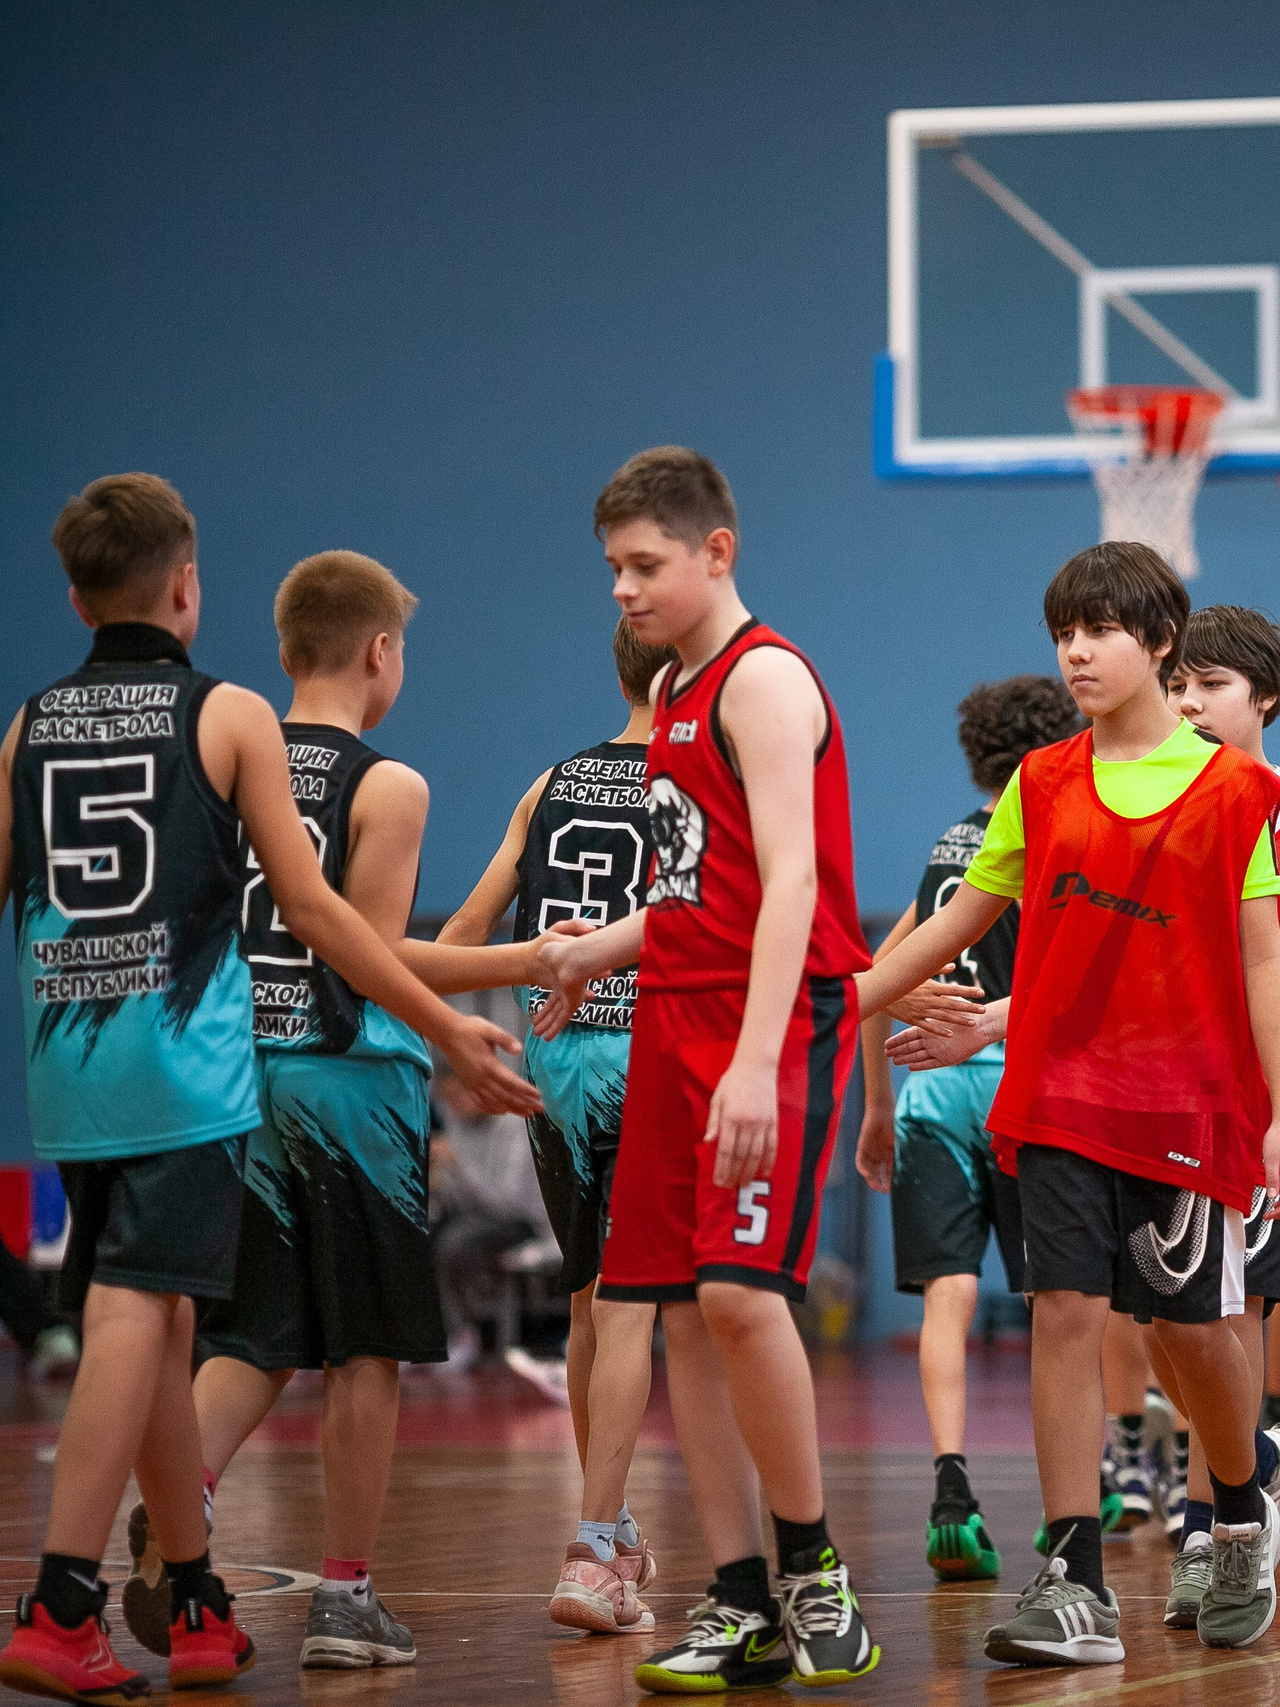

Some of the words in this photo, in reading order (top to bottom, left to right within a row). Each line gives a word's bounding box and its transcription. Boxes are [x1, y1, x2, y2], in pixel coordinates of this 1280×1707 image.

[39, 684, 179, 713] ФЕДЕРАЦИЯ
[29, 713, 175, 744] БАСКЕТБОЛА
[561, 757, 649, 783] ФЕДЕРАЦ
[550, 779, 650, 808] БАСКЕТБОЛ
[43, 753, 155, 920] 5
[538, 819, 644, 935] 3
[1047, 871, 1177, 929] Demix
[31, 924, 168, 967] ЧУВАШСКОЙ
[33, 965, 169, 1002] РЕСПУБЛИКИ
[251, 979, 311, 1009] СКОЙ
[252, 1013, 308, 1039] ЛИКИ
[733, 1179, 772, 1245] 5
